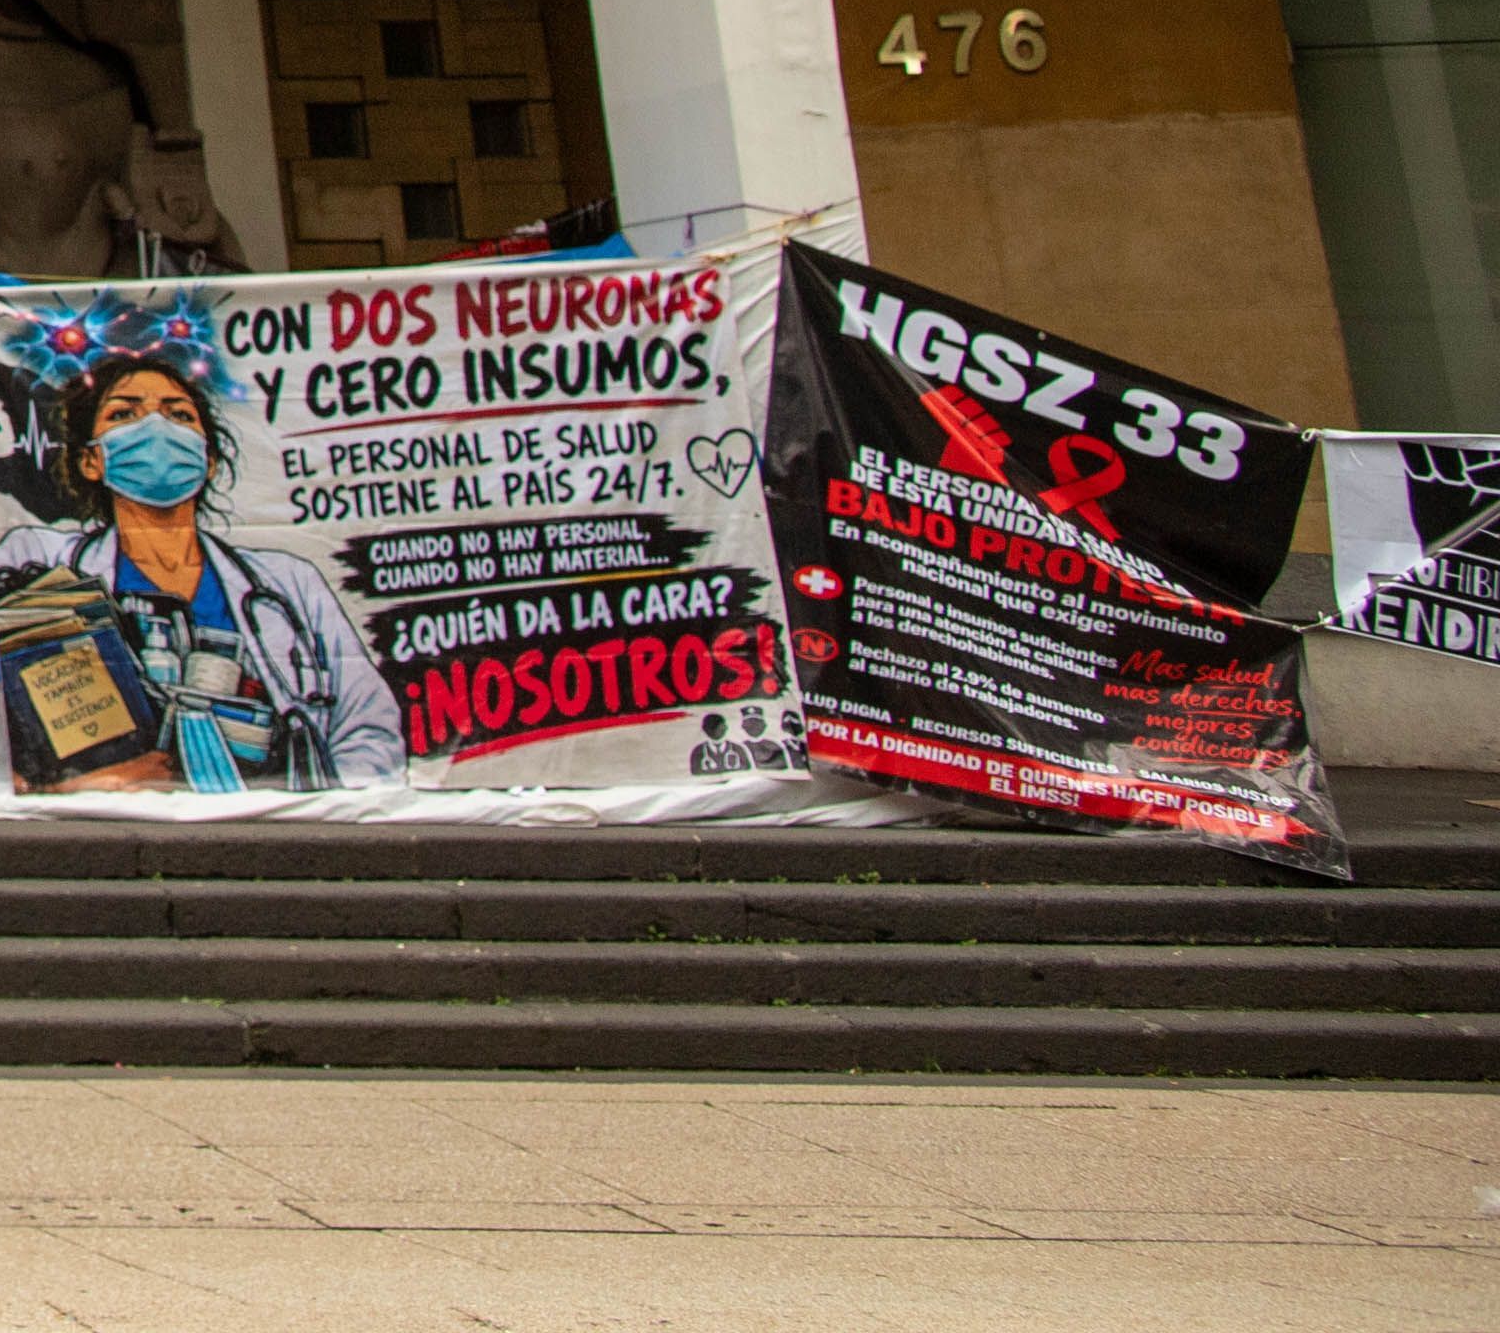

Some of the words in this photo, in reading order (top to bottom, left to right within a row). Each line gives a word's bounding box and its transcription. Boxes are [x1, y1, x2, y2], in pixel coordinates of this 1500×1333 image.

[877, 8, 1048, 75] 476
[225, 302, 312, 358] CON
[326, 284, 438, 353] DOS
[455, 268, 725, 340] NEURONAS
[253, 368, 284, 424] Y
[305, 355, 442, 420] CERO
[463, 334, 731, 405] INSUMOS,
[837, 278, 1097, 431] HGSZ
[1112, 387, 1247, 481] 33
[282, 448, 317, 480] EL
[331, 431, 493, 476] PERSONAL
[506, 428, 543, 462] DE
[559, 421, 658, 457] SALUD
[857, 444, 892, 475] EL
[895, 456, 1049, 522] PERSONAL
[290, 477, 441, 524] SOSTIENE
[453, 475, 492, 510] AL
[504, 460, 575, 507] PAÍS
[587, 461, 684, 501] 24/7.
[826, 477, 957, 549] BAJO
[887, 474, 955, 517] ESTA
[960, 498, 1079, 548] UNIDAD
[369, 536, 454, 565] CUANDO
[460, 531, 491, 557] NO
[499, 526, 537, 553] HAY
[544, 518, 651, 549] PERSONAL,
[374, 563, 459, 592] CUANDO
[465, 557, 496, 583] NO
[504, 551, 543, 578] HAY
[551, 544, 669, 573] MATERIAL...
[392, 597, 506, 663] ¿QUIÉN
[515, 595, 561, 637] DA
[569, 589, 614, 631] LA
[621, 574, 734, 627] CARA?
[853, 575, 933, 611] Personal
[946, 603, 1020, 640] insumos
[1019, 630, 1119, 670] suficientes
[864, 530, 1057, 603] acompañamiento
[1089, 598, 1228, 644] movimiento
[901, 557, 992, 601] nacional
[993, 589, 1038, 616] que
[1039, 604, 1117, 637] exige:
[851, 593, 896, 615] para
[933, 615, 1008, 651] atención
[1033, 645, 1100, 680] calidad
[897, 619, 1057, 681] derechohabientes.
[1119, 649, 1188, 681] Mas
[1193, 658, 1282, 691] salud,
[406, 623, 781, 756] ¡NOSOTROS!
[850, 639, 929, 671] Rechazo
[949, 665, 998, 693] 2.9%
[1025, 687, 1108, 725] aumento
[867, 660, 933, 688] salario
[963, 685, 1080, 732] trabajadores.
[839, 696, 893, 724] DIGNA
[910, 715, 1005, 749] RECURSOS
[1006, 735, 1121, 775] SUFFICIENTES
[1137, 768, 1227, 794] SALARIOS
[1227, 783, 1297, 809] JUSTOS
[1132, 734, 1291, 767] condiciones
[1145, 711, 1256, 739] mejores
[806, 718, 850, 742] POR
[881, 735, 983, 772] DIGNIDAD
[1018, 765, 1114, 798] QUIENES
[1112, 783, 1182, 811] HACEN
[1184, 797, 1276, 829] POSIBLE
[1019, 783, 1081, 808] IMSS!
